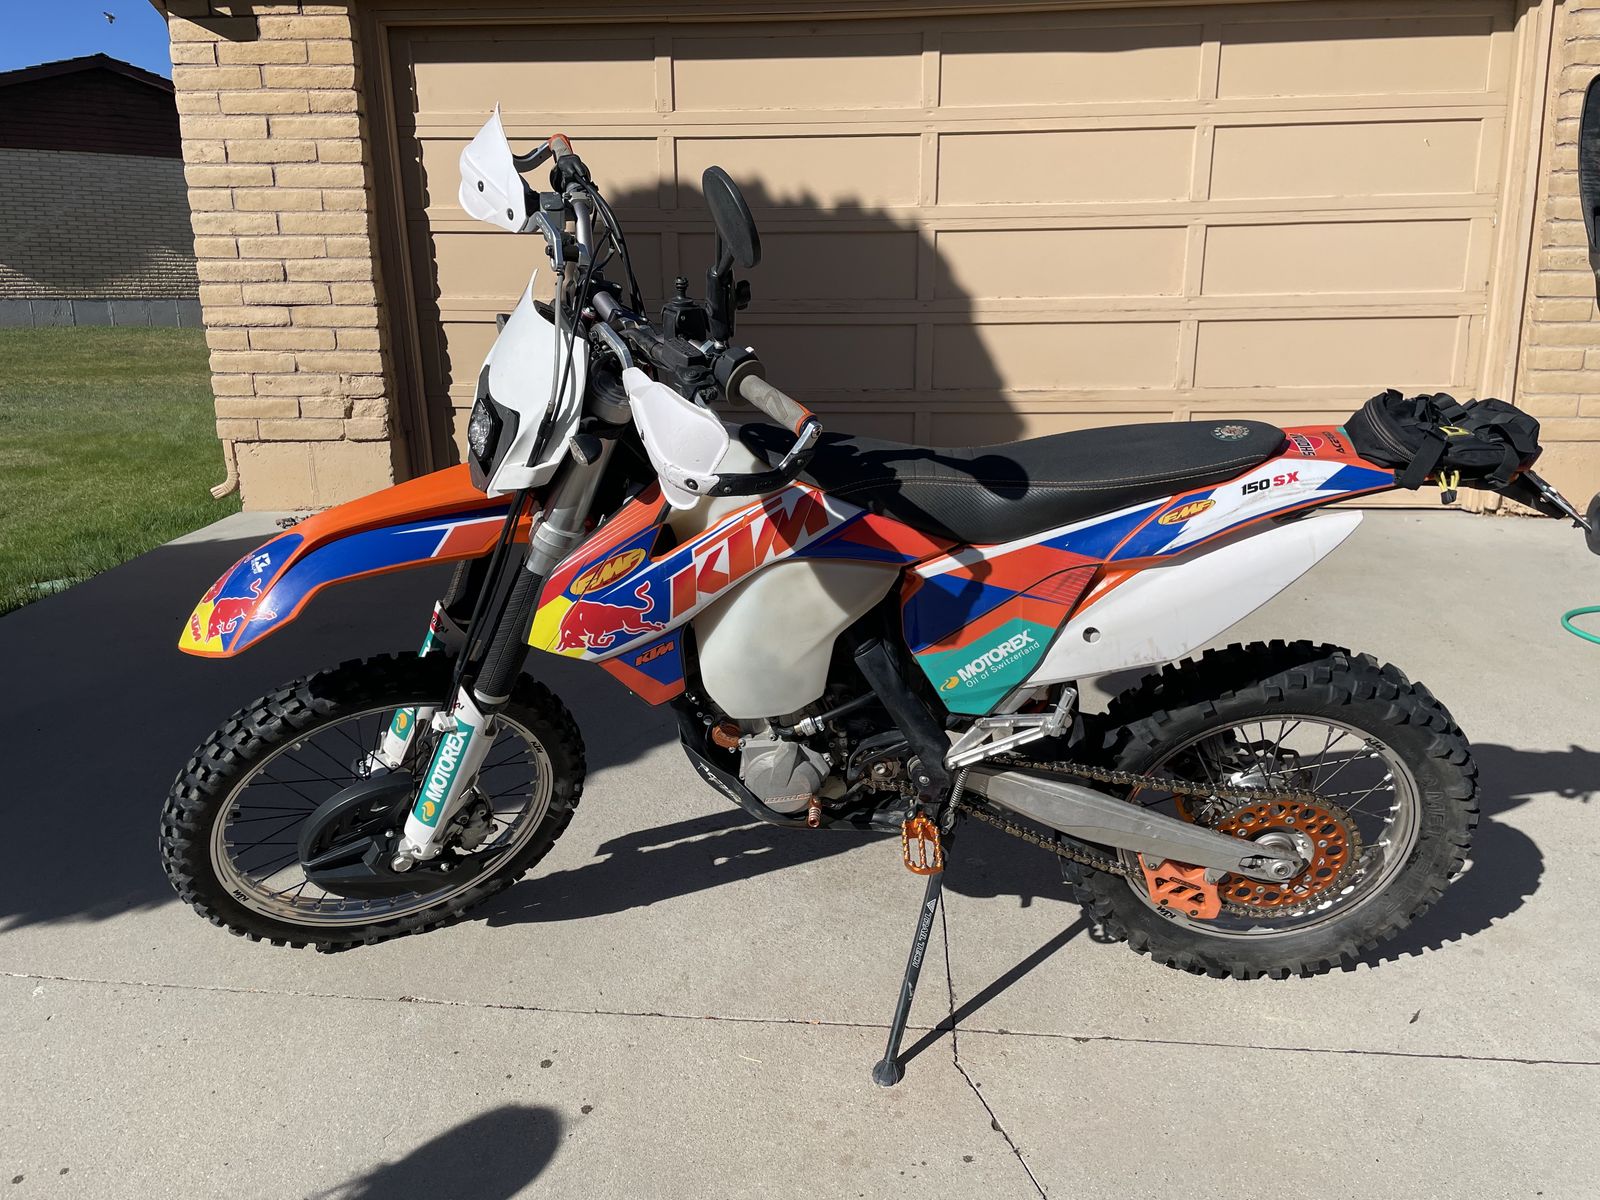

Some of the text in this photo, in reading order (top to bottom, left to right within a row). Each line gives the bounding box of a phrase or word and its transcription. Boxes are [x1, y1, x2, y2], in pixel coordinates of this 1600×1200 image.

[1241, 471, 1299, 496] 150 SX
[1160, 500, 1213, 524] FMF
[672, 490, 830, 619] KTM
[573, 550, 643, 595] FMF
[635, 639, 674, 668] KTM
[956, 629, 1035, 682] MOTOREX
[965, 641, 1040, 688] Oil of Switzerland
[1365, 737, 1386, 751] KTM
[425, 731, 468, 803] MOTOREX
[232, 889, 250, 902] KTM
[1156, 905, 1177, 919] KTM
